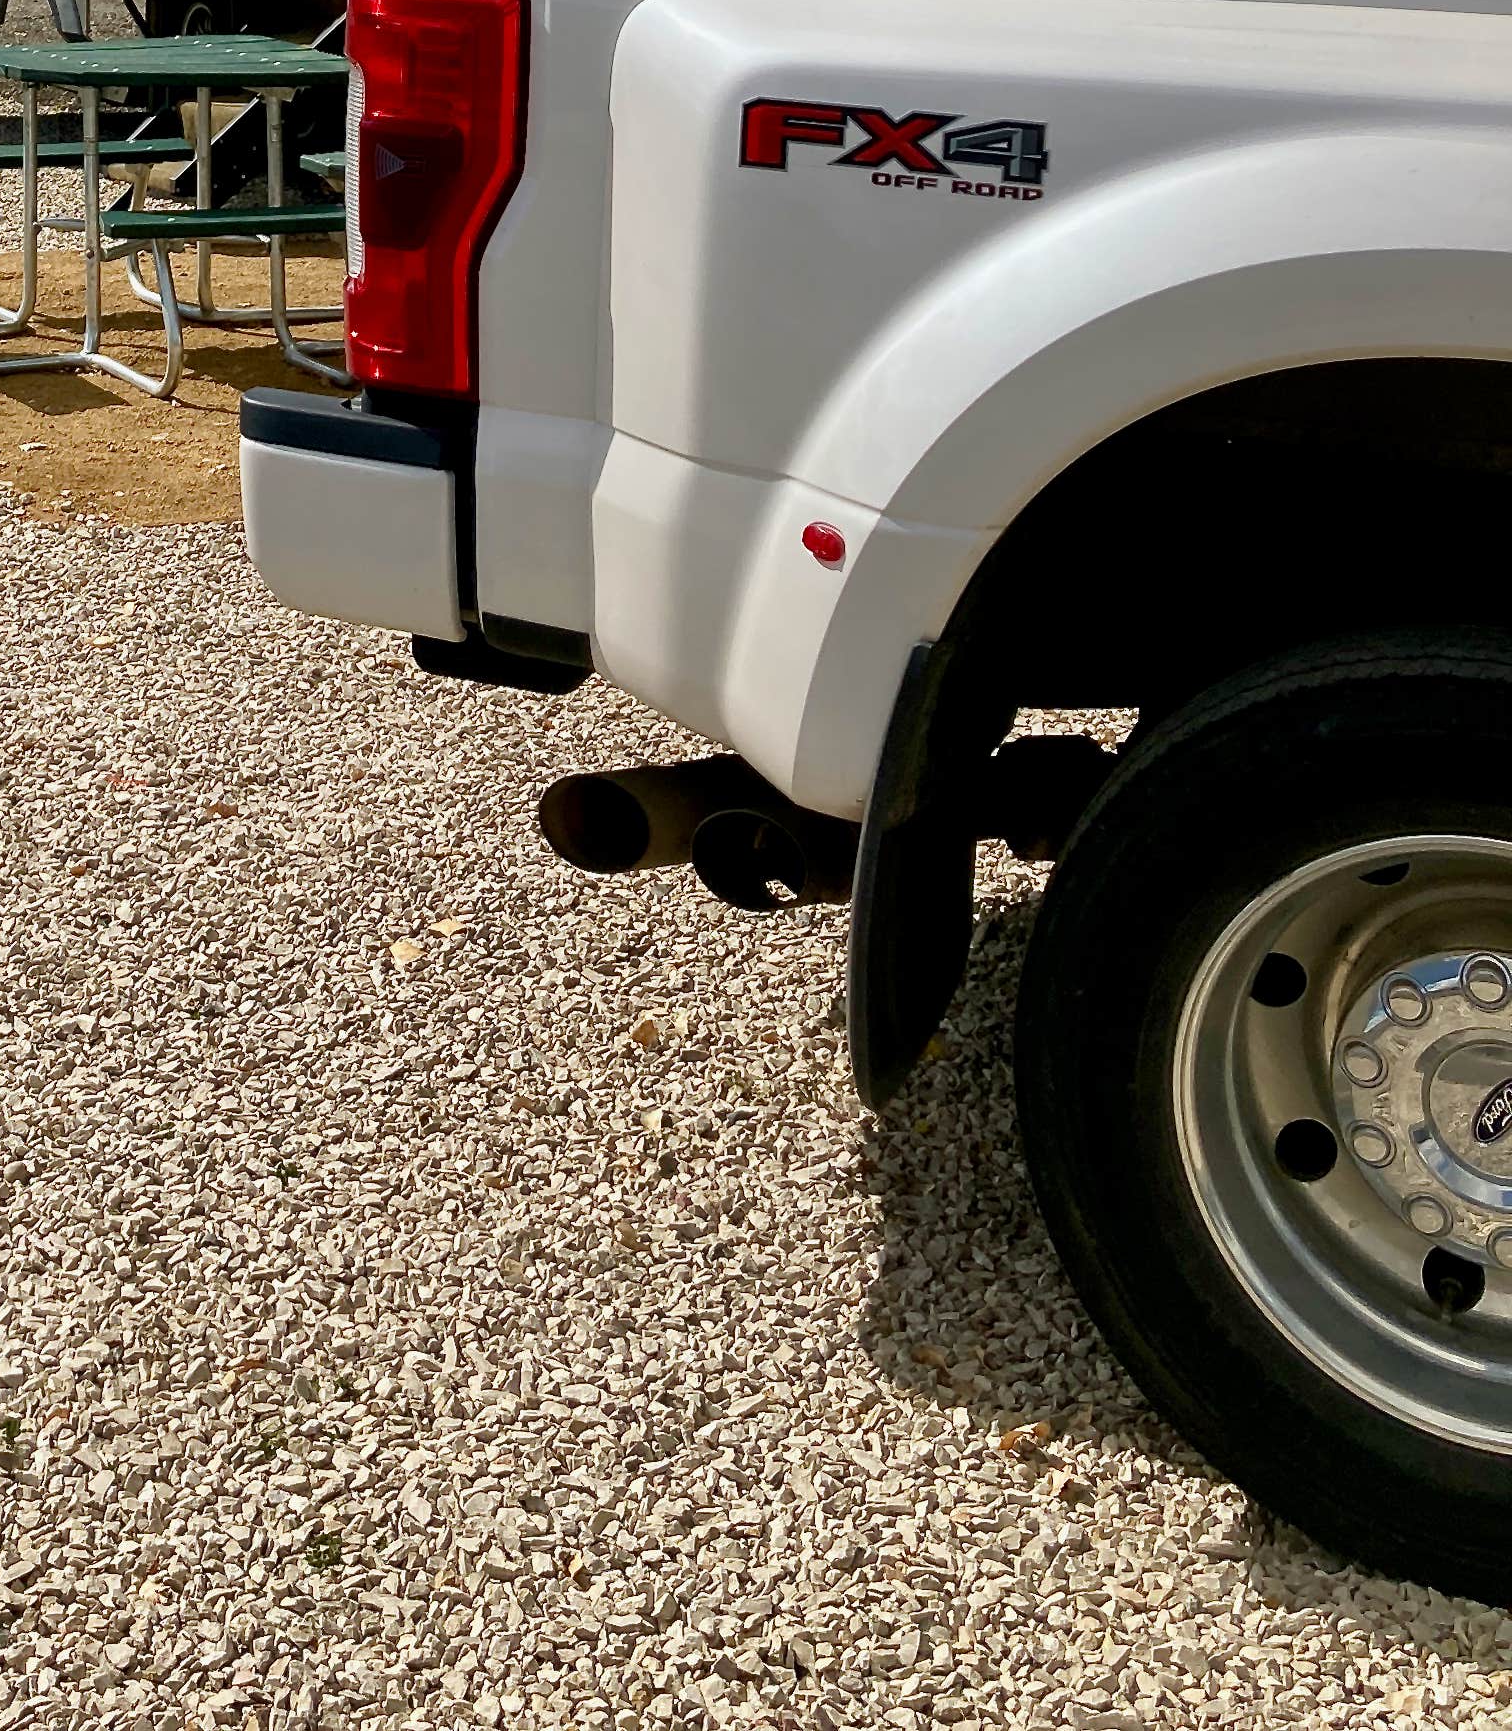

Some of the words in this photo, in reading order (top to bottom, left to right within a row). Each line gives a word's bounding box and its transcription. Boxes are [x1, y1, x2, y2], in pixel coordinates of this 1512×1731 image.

[738, 96, 1050, 186] FX4
[871, 171, 938, 190] OFF
[951, 179, 1044, 200] ROAD
